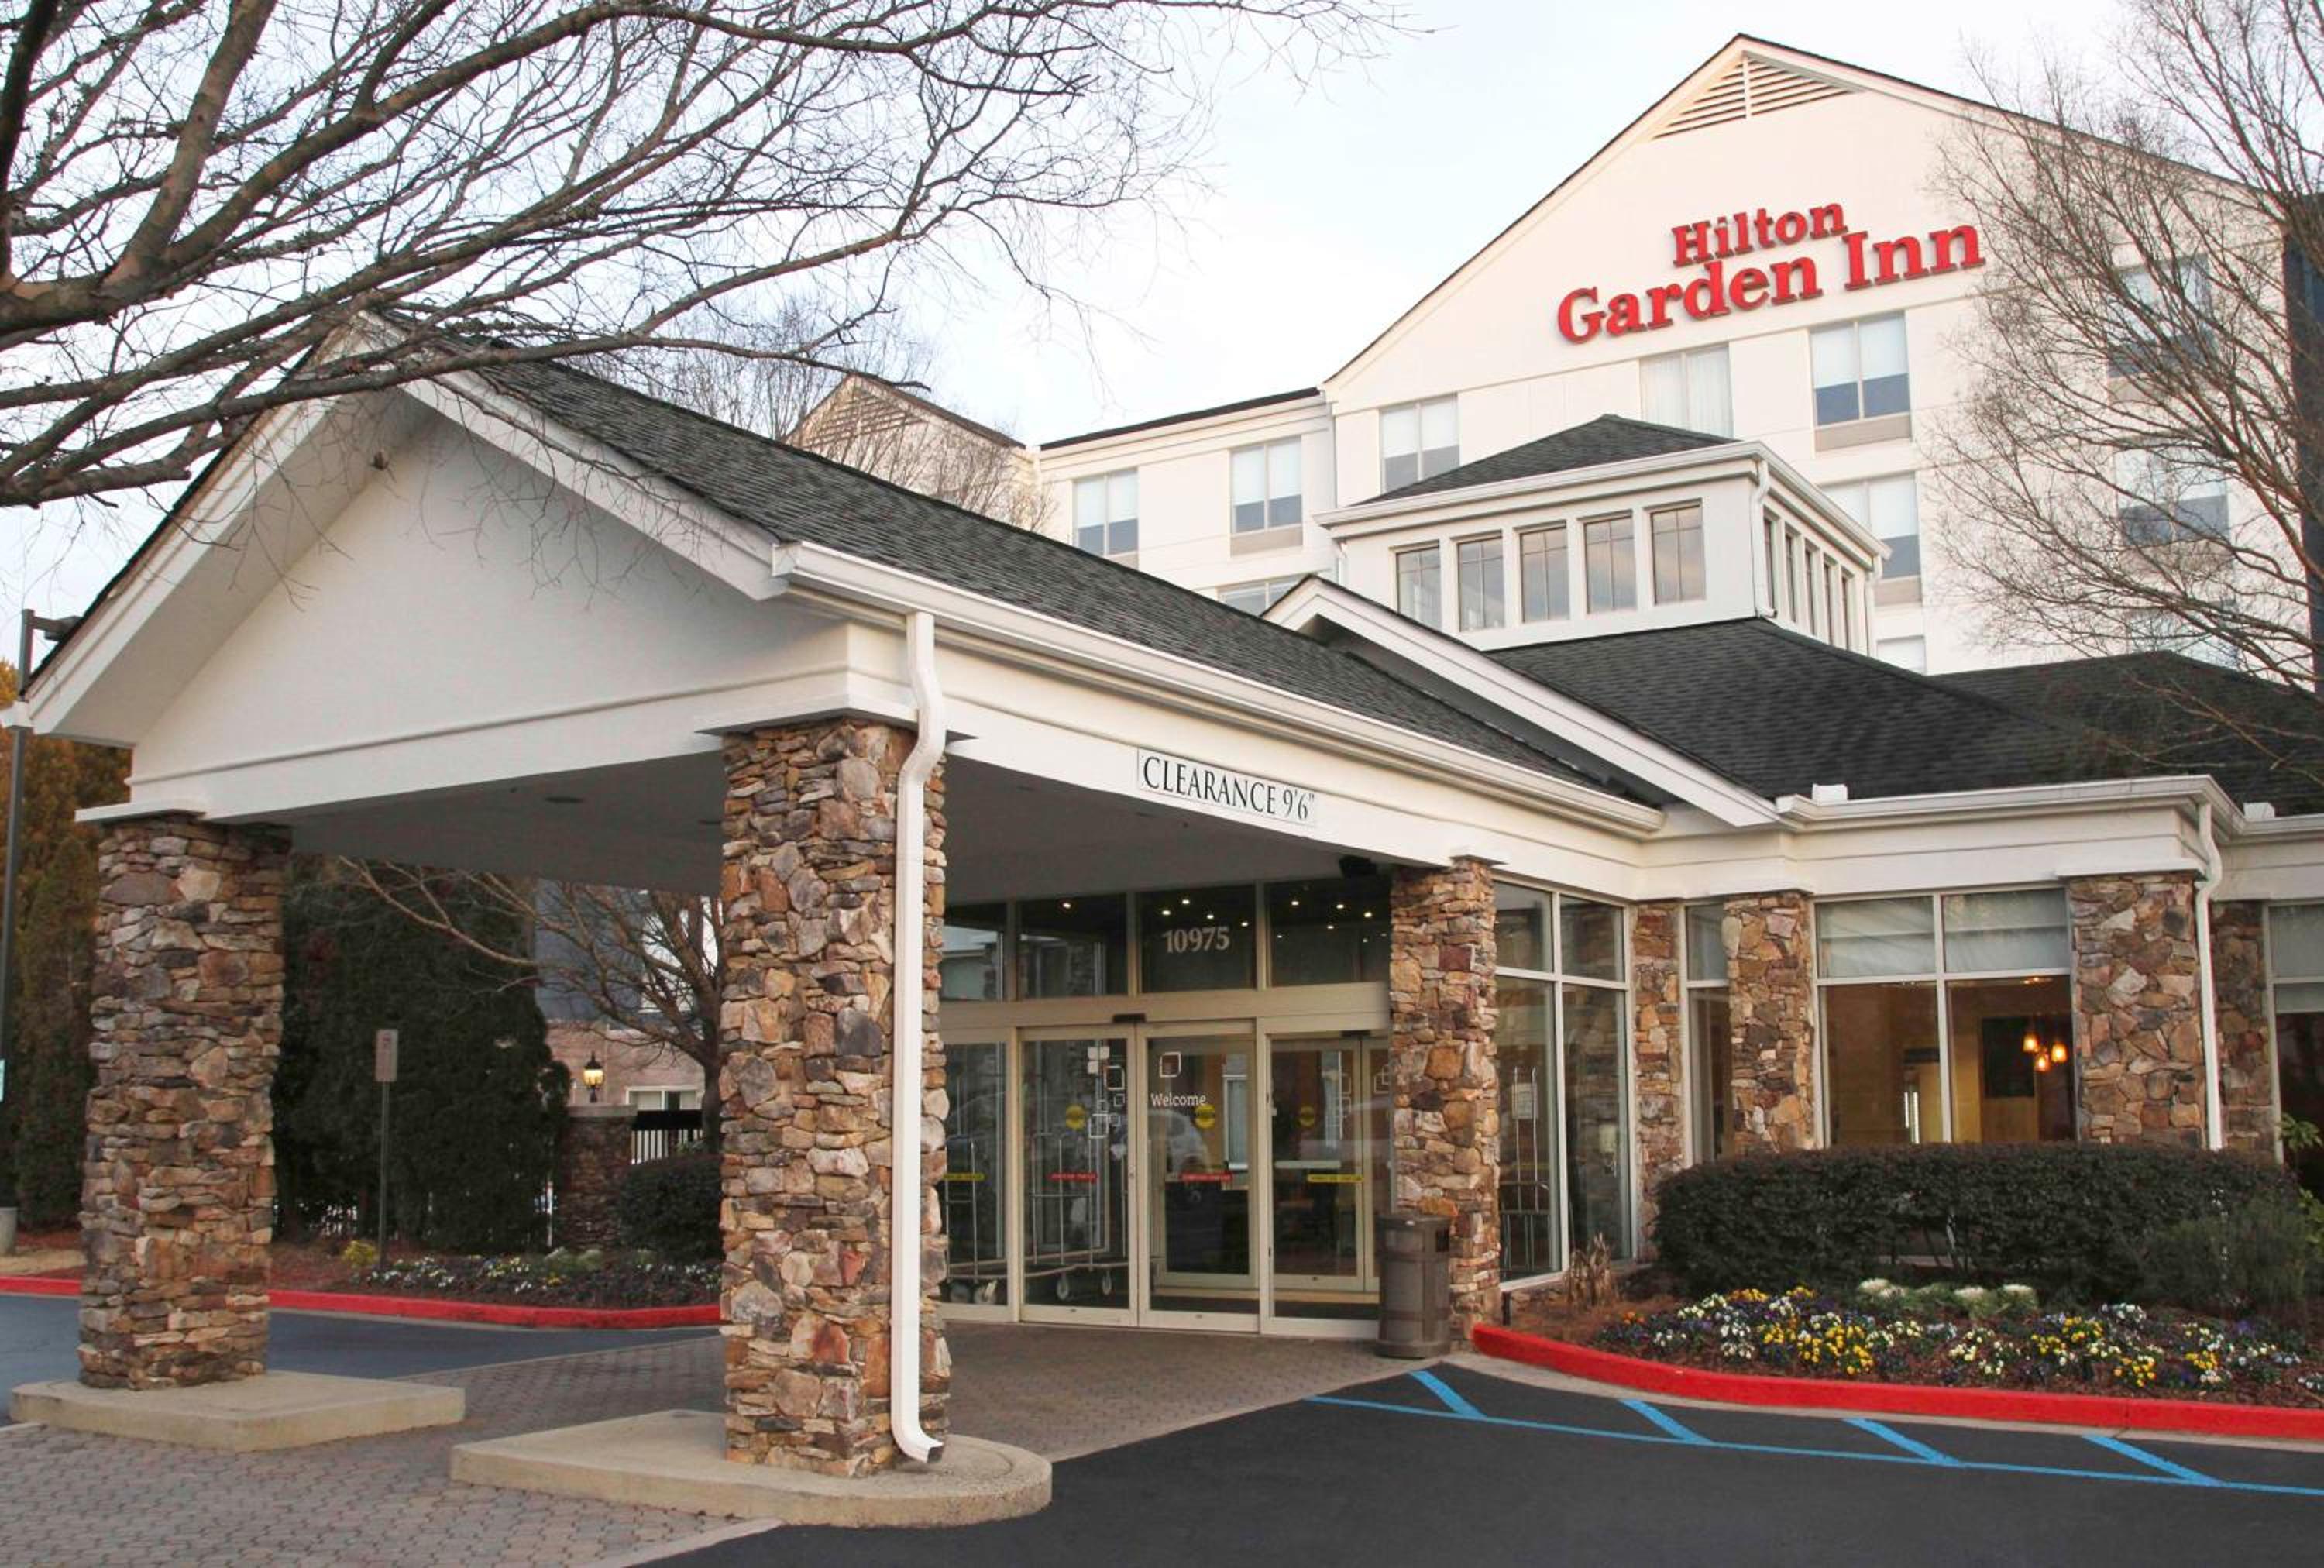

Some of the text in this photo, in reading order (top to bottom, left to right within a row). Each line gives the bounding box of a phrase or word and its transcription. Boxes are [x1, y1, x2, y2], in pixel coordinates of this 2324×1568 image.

[1672, 202, 1848, 267] Hilton
[1558, 224, 1986, 344] Garden Inn
[1143, 756, 1276, 814] CLEARANCE
[1163, 927, 1230, 954] 10975
[1150, 1092, 1207, 1107] Welcome
